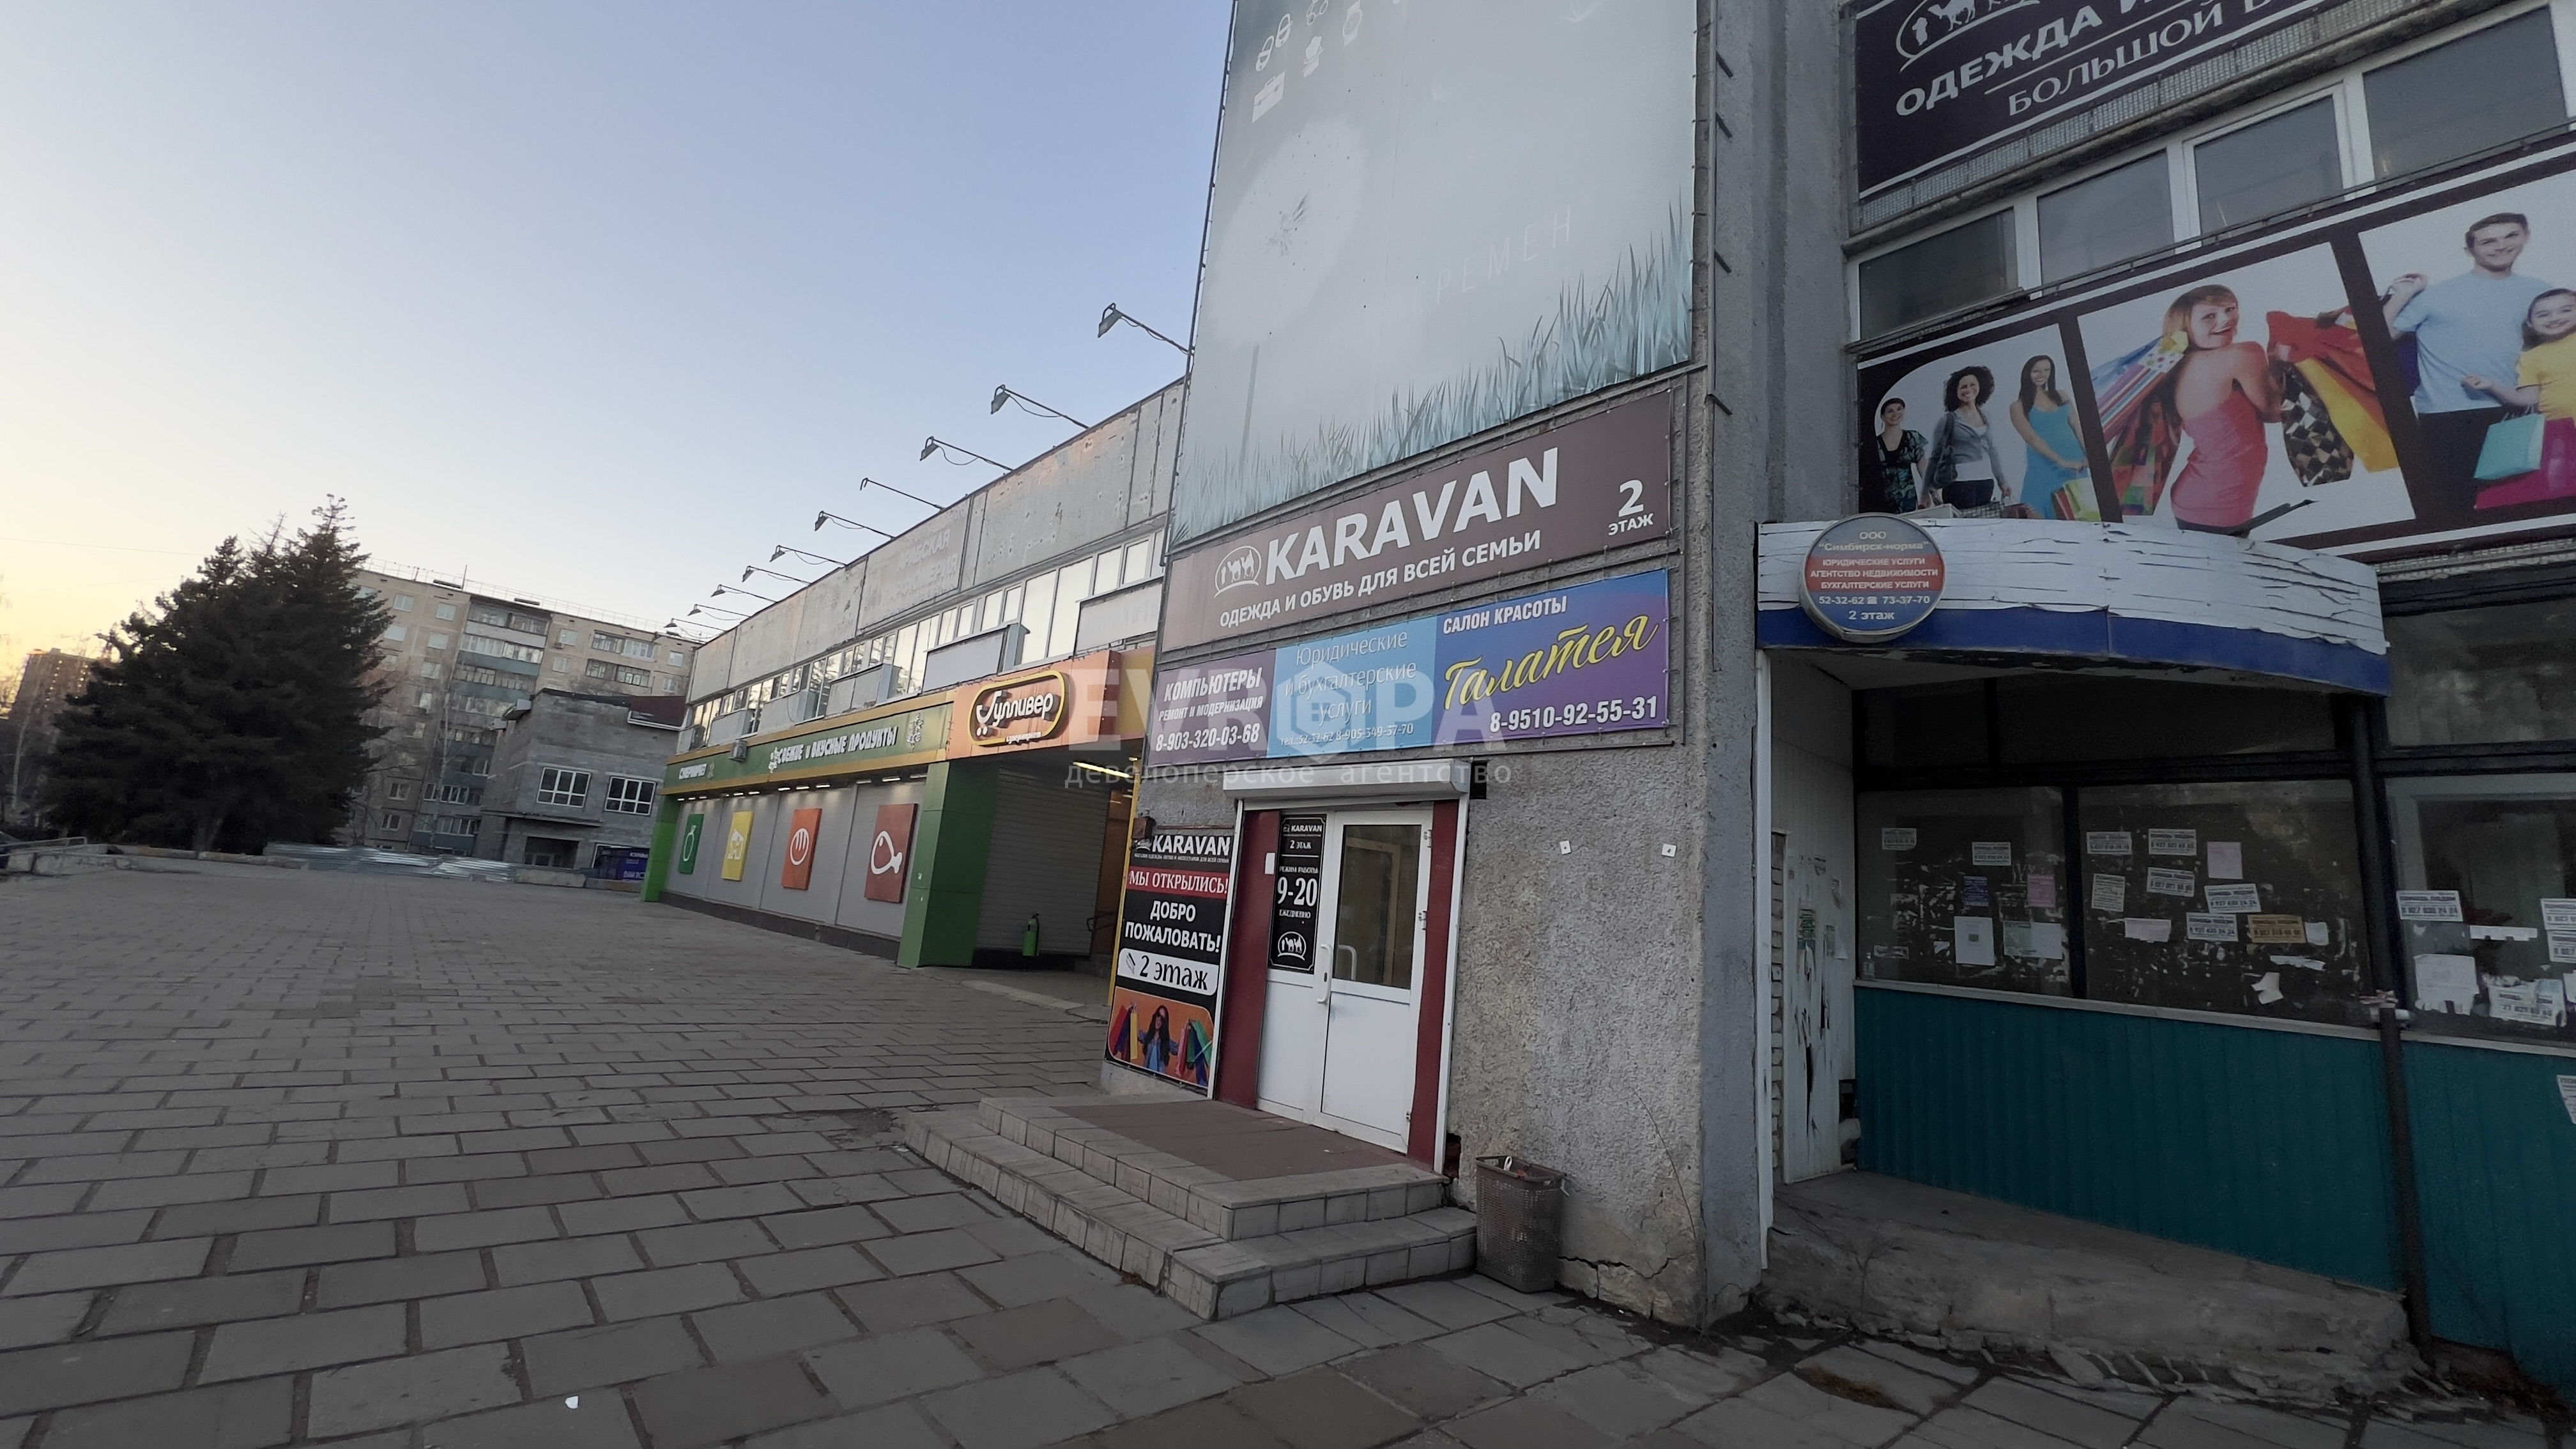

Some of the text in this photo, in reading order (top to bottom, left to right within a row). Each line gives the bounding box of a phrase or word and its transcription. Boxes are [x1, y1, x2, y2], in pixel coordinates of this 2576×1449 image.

[1896, 5, 2103, 116] ОДЕЖДА
[2009, 0, 2223, 116] БОЛЬШОЙ
[1618, 479, 1644, 517] 2
[1266, 447, 1558, 585] KARAVAN
[1608, 513, 1653, 535] ЭТАЖ
[1859, 531, 1887, 539] ООО
[1823, 558, 1925, 567] ЮРИДИЧЕСКИЕ УСЛУГИ
[1862, 569, 1938, 578] НЕДВИЖИМОСТИ
[1220, 530, 1540, 628] ОДЕЖДА И ОБУВЬ ДЛЯ ВСЕЙ СЕМЬИ
[1443, 595, 1567, 634] САЛОН КРАСОТЫ
[1819, 595, 1930, 605] 52-32-62 73-37-70
[1848, 611, 1895, 620] 2 этаж
[1296, 631, 1407, 670] Юридические
[1164, 667, 1262, 702] КОМПЬЮТЕРЫ
[1285, 663, 1416, 700] и бухгалтерские
[1158, 696, 1264, 722] РЕМОНТ И МОДЕРНИЗАЦИЯ
[1319, 700, 1372, 726] услуги
[1490, 695, 1658, 733] 8-9510-92-55-31
[848, 726, 898, 752] ПРОДУКТЫ
[1155, 723, 1261, 752] 8-903-320-03-68
[1152, 834, 1230, 856] KARAVAN
[1289, 839, 1295, 849] 2
[1129, 871, 1229, 894] МЫ ОТКРЫЛИСЬ!
[1277, 877, 1318, 907] 9-20
[1150, 900, 1196, 922] ДОБРО
[1124, 921, 1221, 953] ПОЖАЛОВАТЬ!
[1140, 955, 1208, 990] 2 этаж
